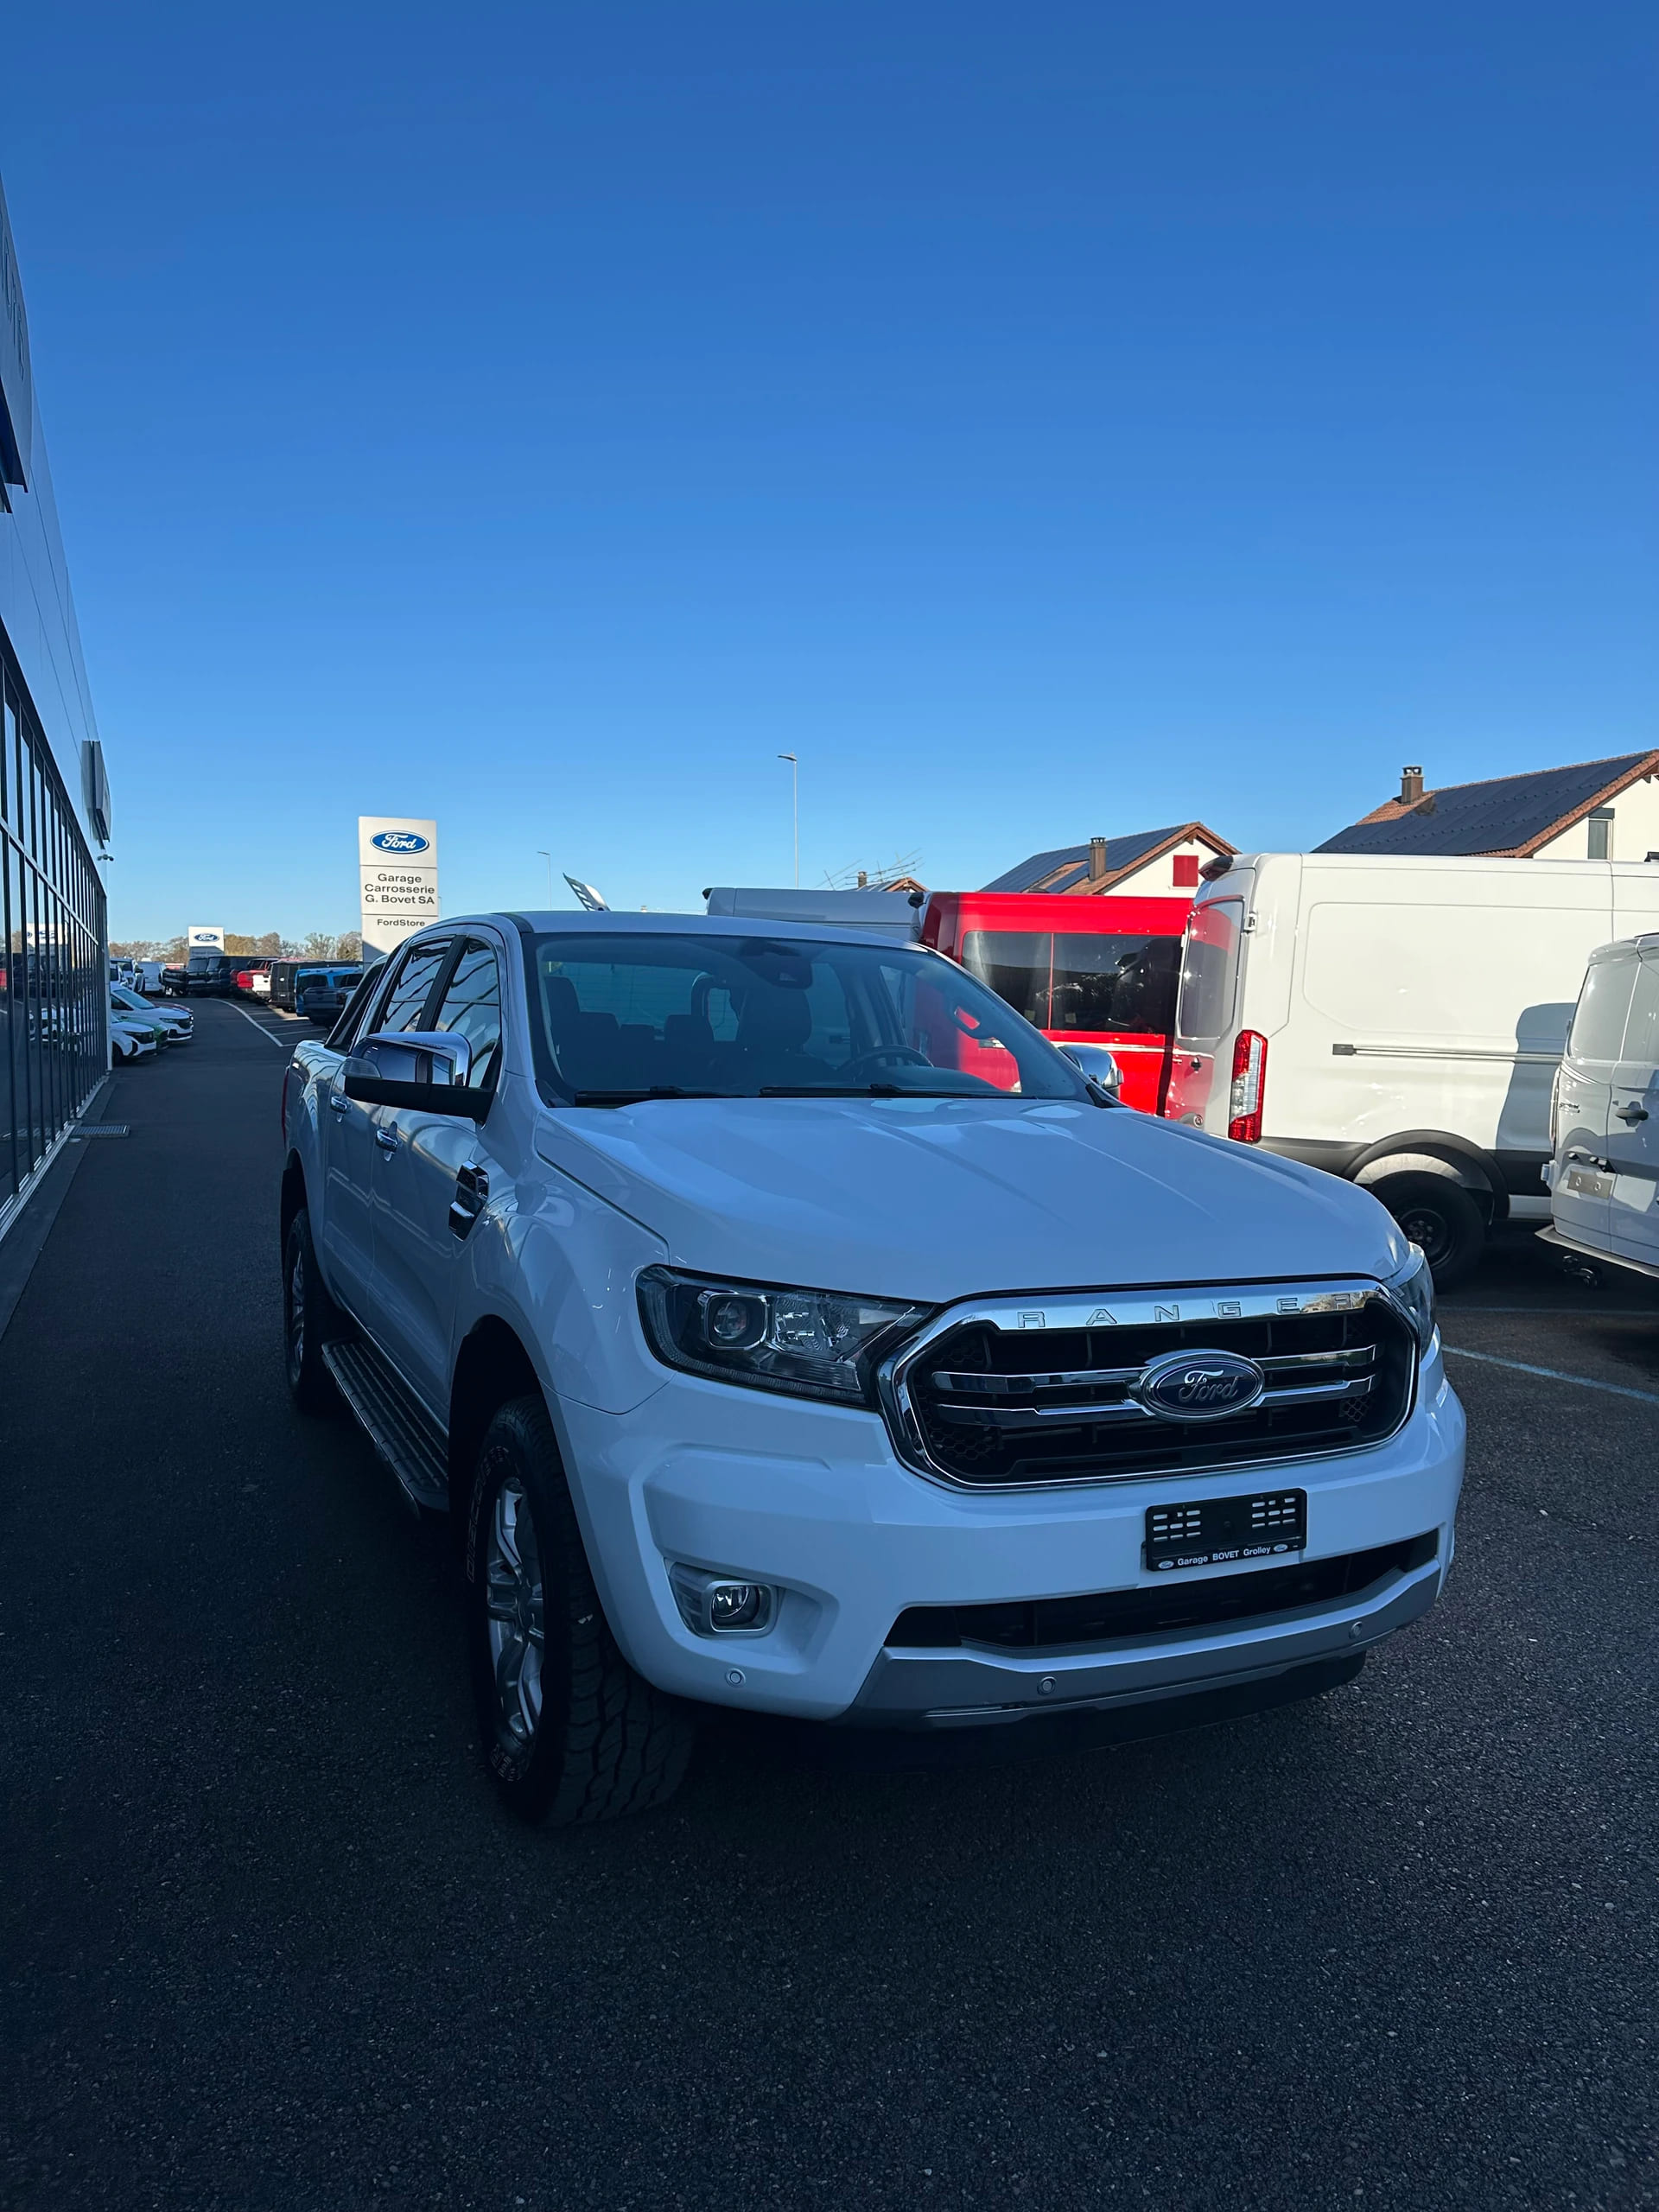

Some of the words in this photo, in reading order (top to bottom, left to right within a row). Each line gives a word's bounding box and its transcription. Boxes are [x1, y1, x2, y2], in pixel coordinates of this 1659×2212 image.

[381, 833, 417, 849] Ford
[378, 873, 423, 884] Garage
[365, 883, 435, 894] Carrosserie
[365, 894, 378, 903] G.
[381, 894, 416, 904] Bovet
[418, 896, 435, 905] SA
[377, 918, 426, 927] FordStore
[1178, 1370, 1241, 1402] Ford
[1177, 1555, 1208, 1566] Garage
[1212, 1550, 1239, 1560] BOVET
[1243, 1546, 1271, 1557] Grolley
